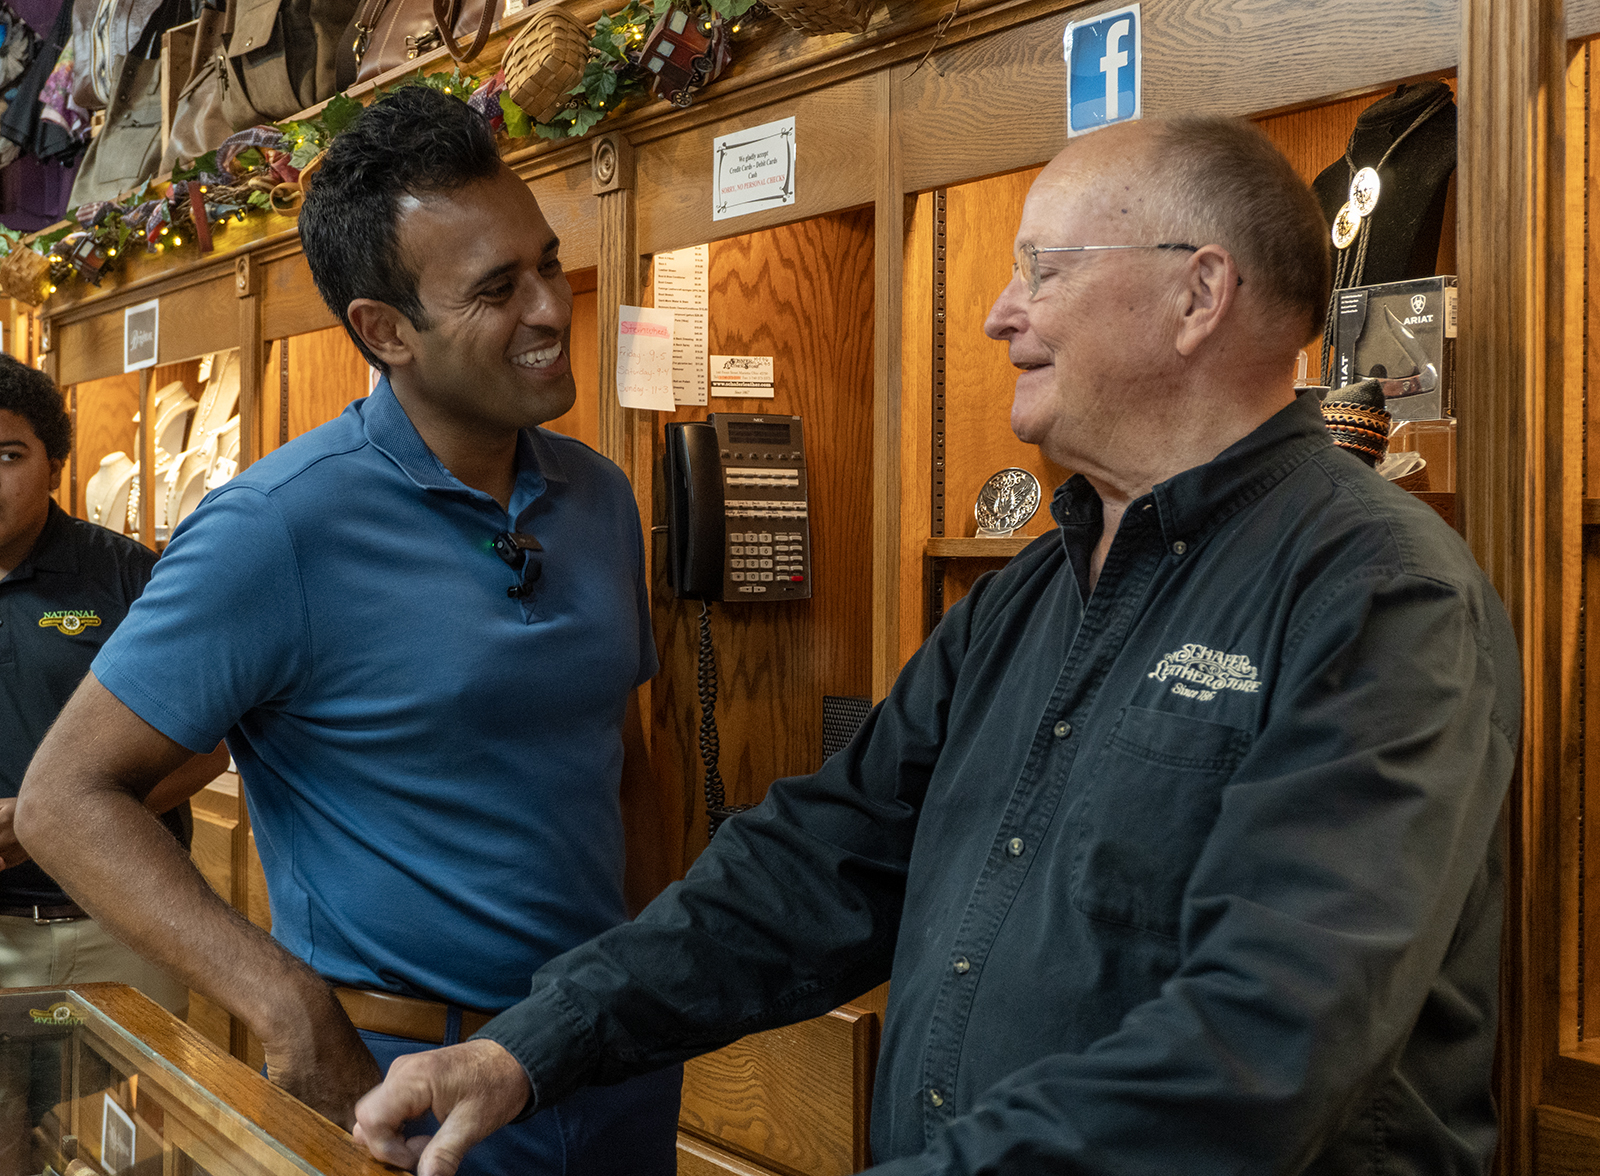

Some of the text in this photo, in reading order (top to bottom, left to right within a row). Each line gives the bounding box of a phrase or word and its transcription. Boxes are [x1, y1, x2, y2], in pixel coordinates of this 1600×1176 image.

[746, 153, 756, 163] gladly
[757, 151, 769, 159] accept
[742, 164, 752, 172] Cards
[744, 178, 766, 189] PERSONAL
[767, 174, 785, 183] CHECKS
[1404, 315, 1434, 325] ARIAT
[1340, 356, 1348, 388] RIAT
[44, 610, 97, 619] NATIONAL
[1176, 644, 1250, 674] SCHAFER
[1212, 672, 1262, 692] STORE
[1172, 682, 1199, 698] Since
